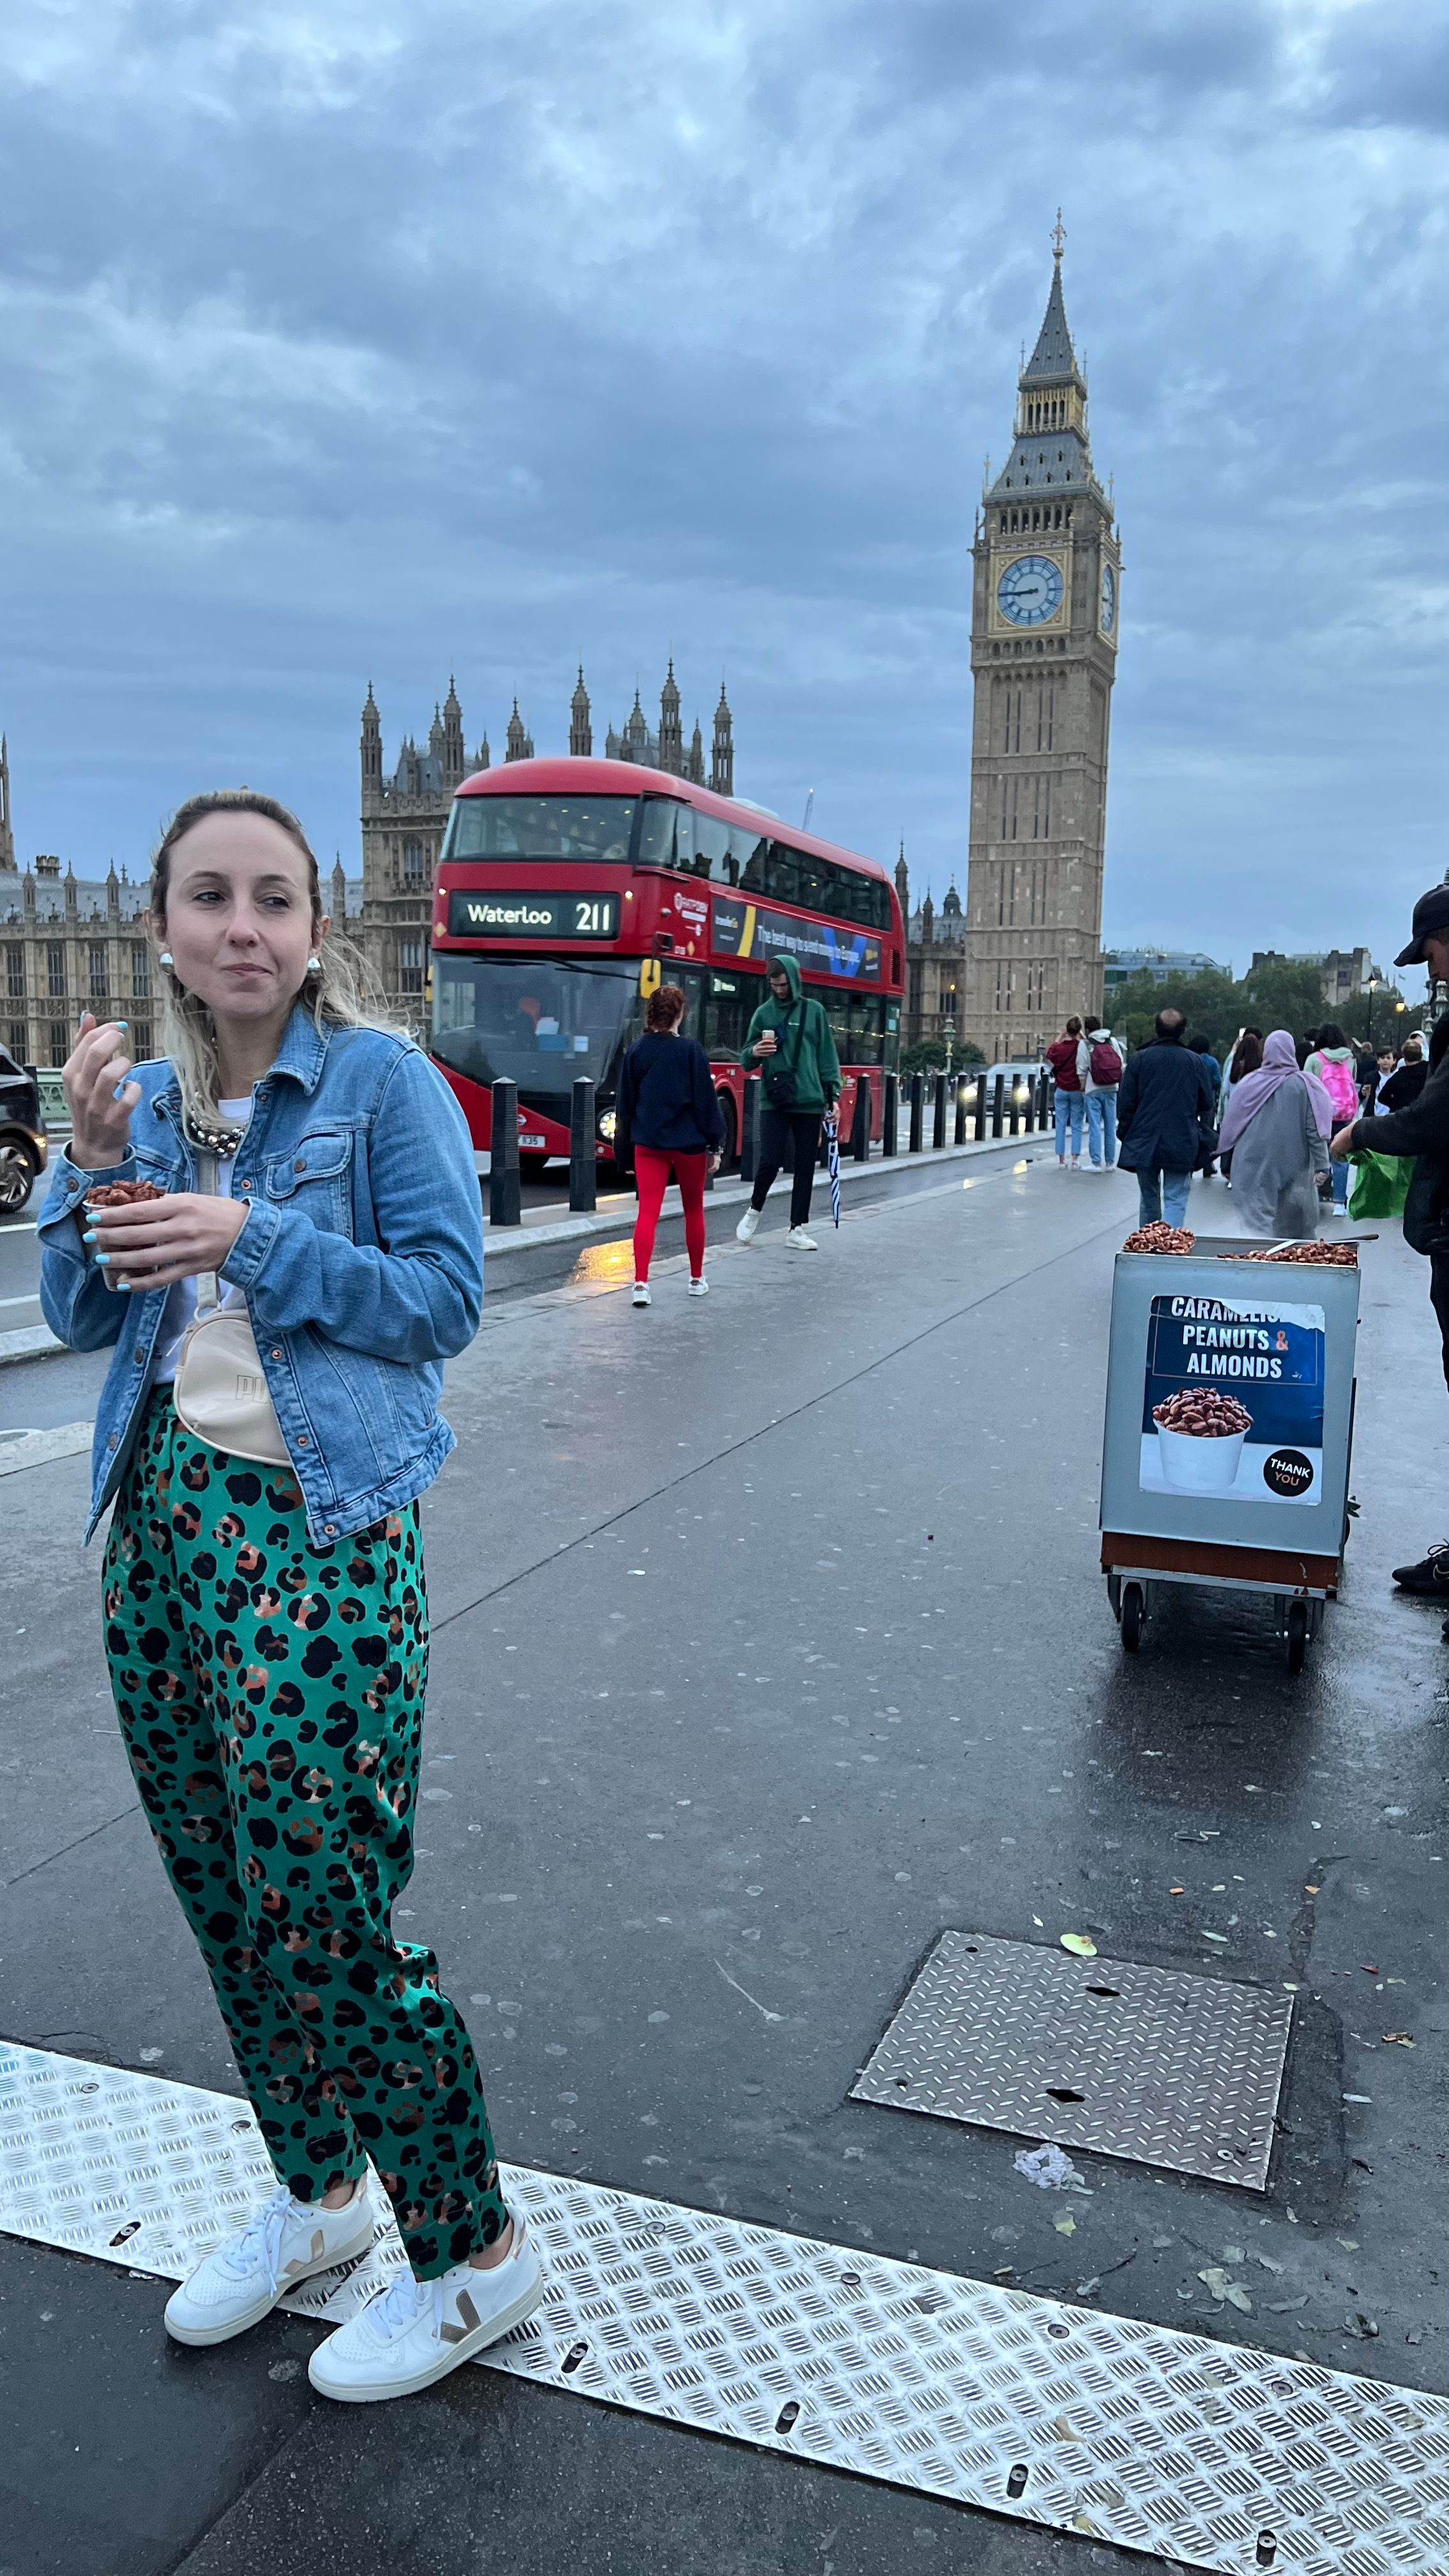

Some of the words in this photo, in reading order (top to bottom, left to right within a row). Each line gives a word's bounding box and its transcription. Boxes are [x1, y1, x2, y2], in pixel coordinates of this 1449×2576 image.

[467, 903, 552, 924] Waterloo
[576, 902, 610, 931] 211
[1183, 1325, 1269, 1351] PEANUTS
[1276, 1331, 1289, 1351] &
[1186, 1353, 1282, 1379] ALMONDS
[1271, 1458, 1310, 1478] THANK
[1275, 1471, 1300, 1487] YOU
